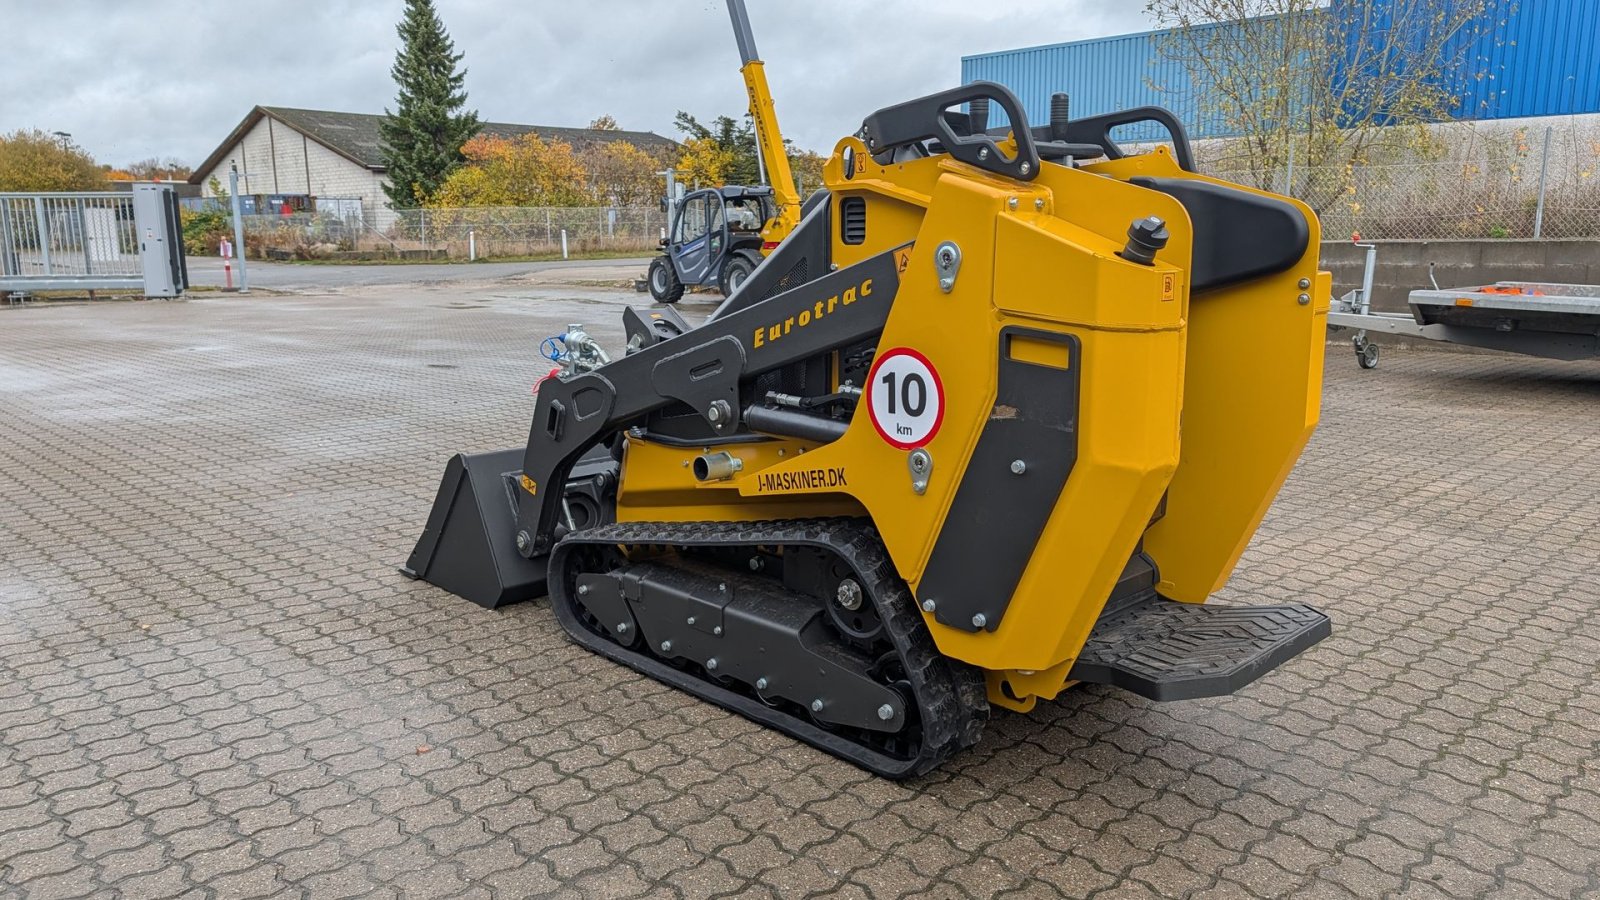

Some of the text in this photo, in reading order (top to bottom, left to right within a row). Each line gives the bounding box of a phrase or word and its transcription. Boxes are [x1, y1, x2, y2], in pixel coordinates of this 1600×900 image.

[754, 278, 873, 348] Eurotrac
[882, 371, 927, 417] 10
[896, 422, 913, 436] km
[757, 467, 848, 492] J-MASKINER.DK
